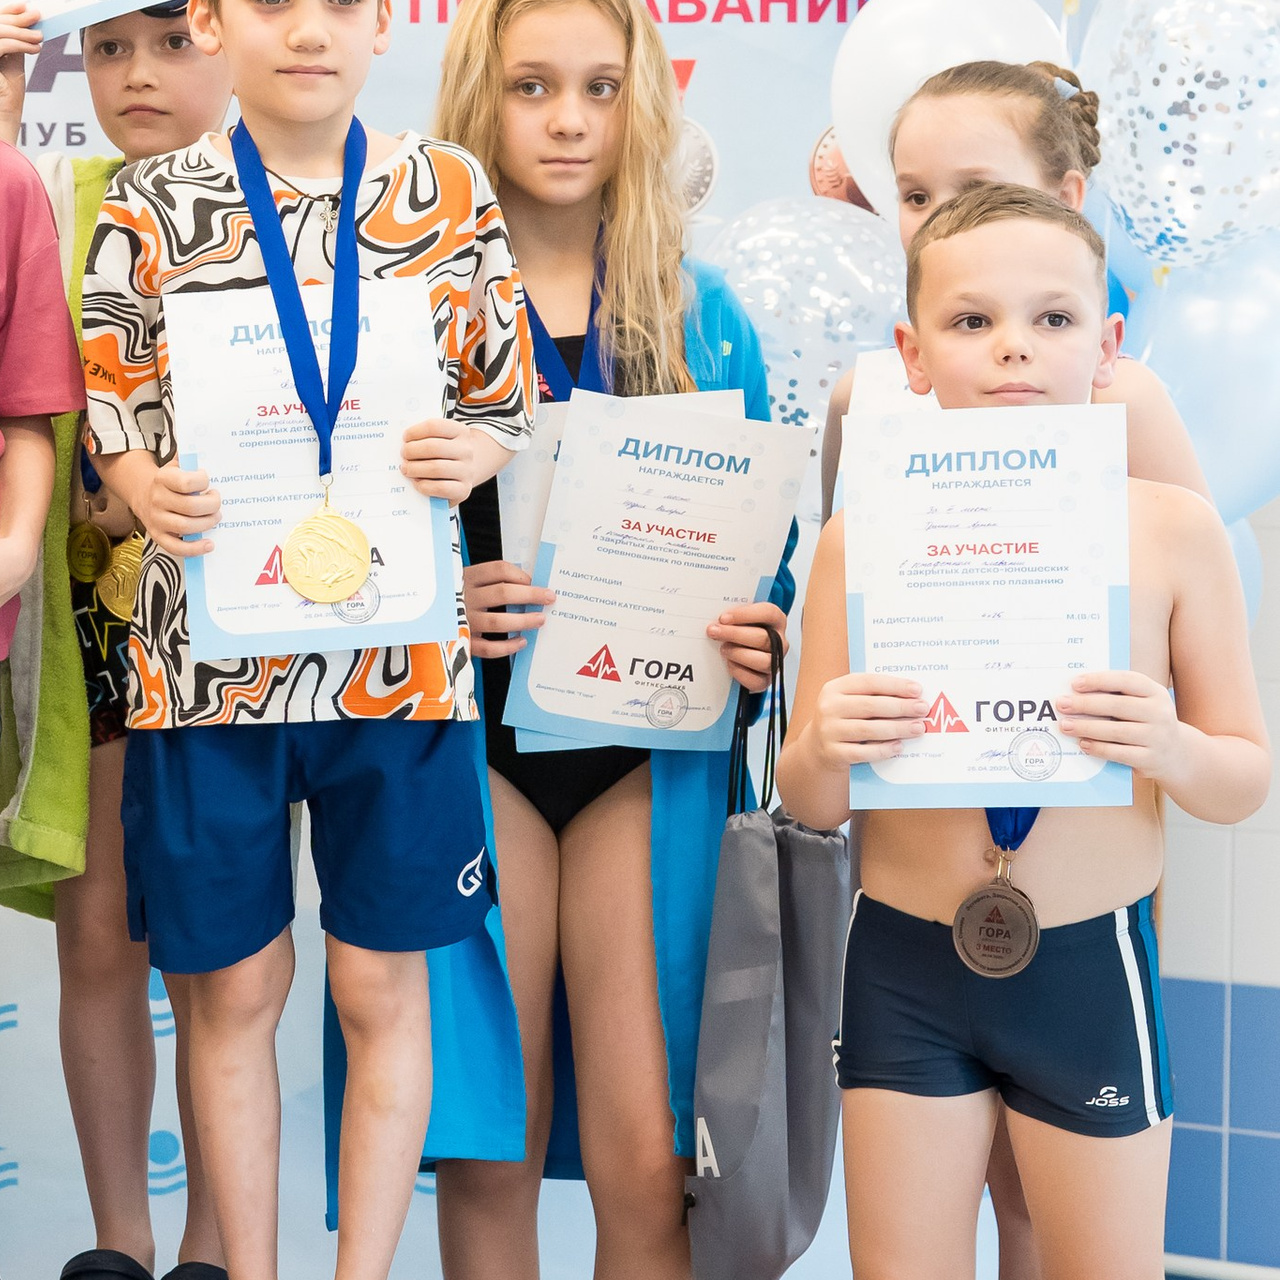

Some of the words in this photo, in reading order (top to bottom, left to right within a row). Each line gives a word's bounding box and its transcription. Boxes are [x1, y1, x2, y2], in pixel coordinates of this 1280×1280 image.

[257, 405, 279, 417] ЗА
[238, 426, 288, 438] закрытых
[239, 437, 317, 448] соревнованиях
[333, 432, 384, 441] плаванию
[618, 437, 751, 475] ДИПЛОМ
[905, 449, 1056, 478] ДИПЛОМ
[220, 473, 275, 484] ДИСТАНЦИИ
[639, 466, 724, 486] НАГРАЖДАЕТСЯ
[932, 479, 1031, 490] НАГРАЖДАЕТСЯ
[222, 496, 276, 505] ОЗРАСТНОЙ
[219, 519, 282, 529] РЕЗУЛЬТАТОМ
[621, 519, 642, 532] ЗА
[646, 523, 717, 544] УЧАСТИЕ
[599, 536, 646, 549] закрытых
[647, 544, 736, 562] детско-юношеских
[927, 545, 951, 556] ЗА
[955, 542, 1040, 556] УЧАСТИЕ
[597, 546, 669, 564] соревнованиях
[683, 561, 729, 572] плаванию
[559, 569, 571, 577] НА
[571, 572, 622, 586] ДИСТАНЦИИ
[907, 568, 959, 577] закрытых
[961, 565, 1069, 574] детско-юношеских
[907, 580, 990, 589] соревнованиях
[1008, 578, 1064, 586] плаванию
[562, 590, 617, 607] ВОЗРАСТНОЙ
[618, 601, 665, 615] КАТЕГОРИИ
[558, 611, 617, 628] РЕЗУЛЬТАТОМ
[886, 616, 944, 625] ДИСТАНЦИИ
[881, 640, 943, 649] ВОЗРАСТНОЙ
[944, 639, 1000, 647] КАТЕГОРИИ
[629, 657, 695, 683] ГОРА
[882, 664, 949, 672] РЕЗУЛЬТАТОМ
[975, 700, 1058, 723] ГОРА
[979, 926, 1011, 940] ГОРА
[983, 944, 1012, 954] МЕСТО
[1085, 1095, 1130, 1108] JOSS
